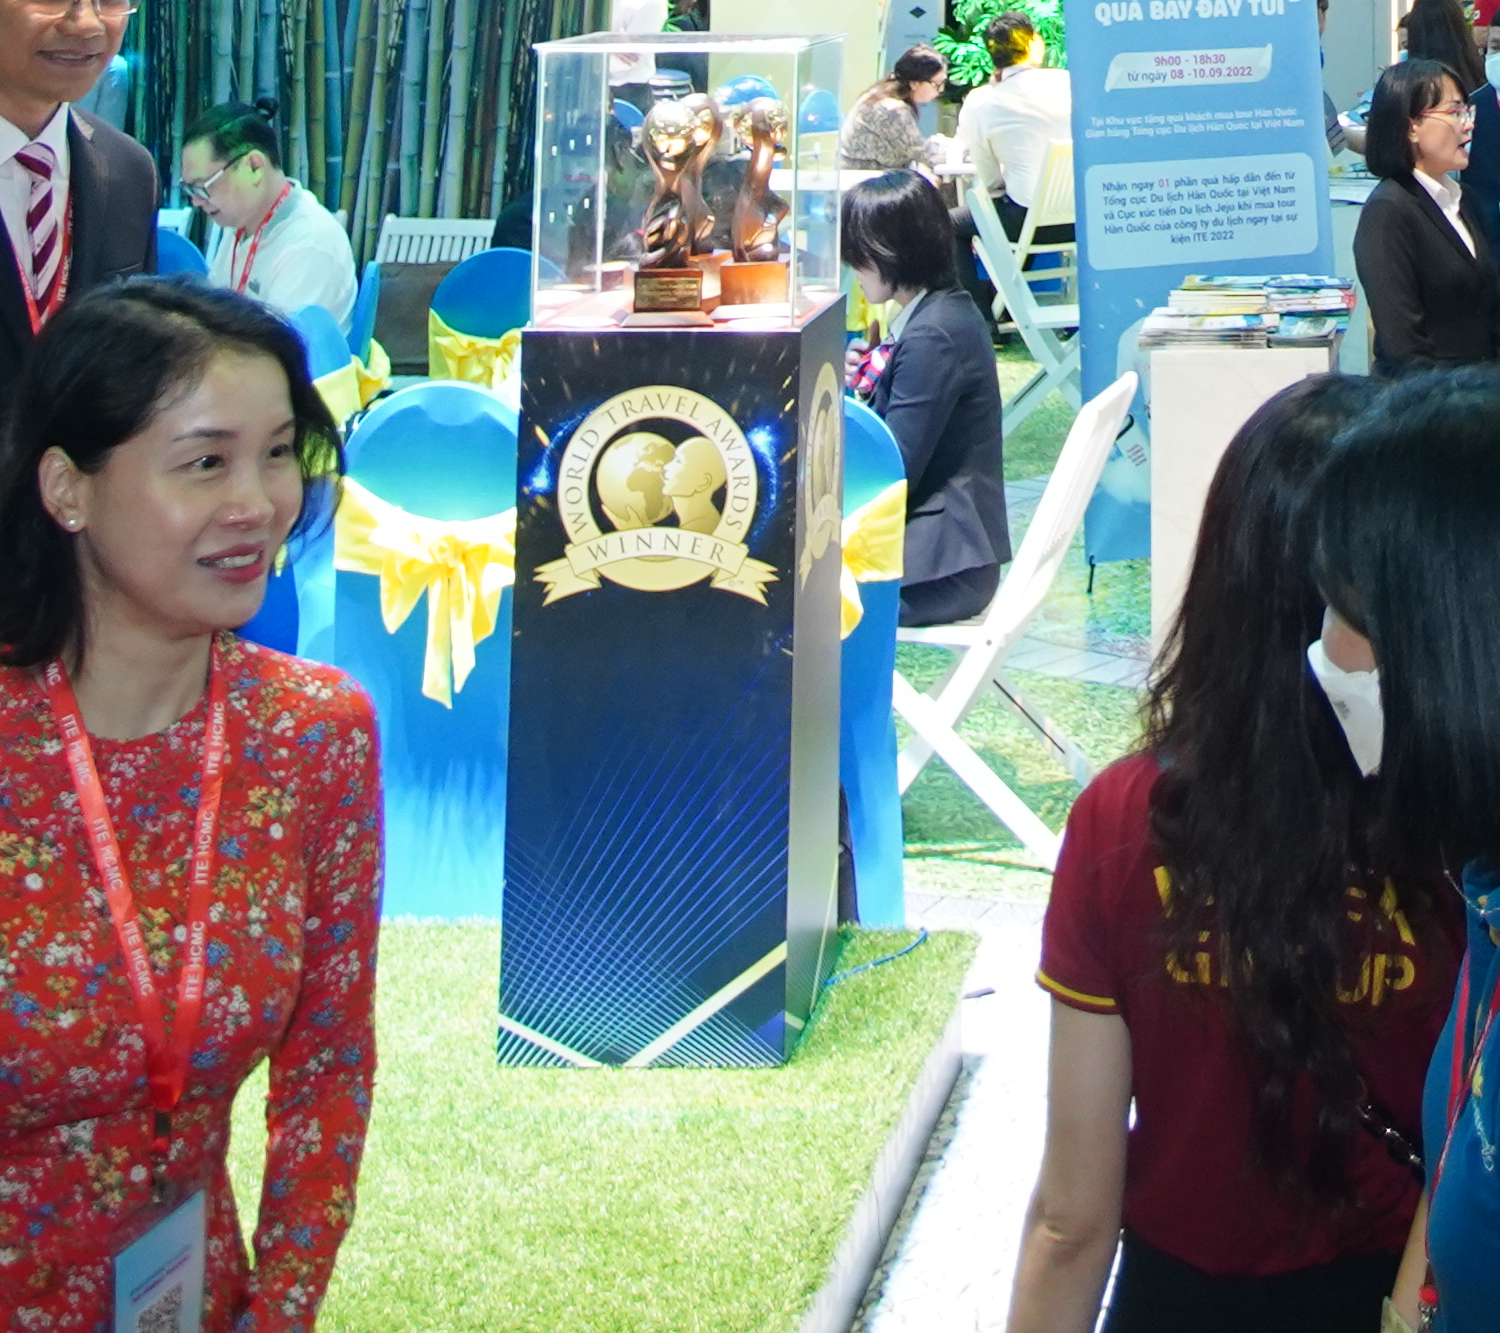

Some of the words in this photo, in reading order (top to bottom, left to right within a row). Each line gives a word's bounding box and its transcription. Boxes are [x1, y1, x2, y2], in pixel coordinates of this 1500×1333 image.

[1154, 56, 1182, 67] 9h00
[1192, 54, 1226, 66] 18h30
[1141, 69, 1167, 85] ngày
[1170, 69, 1185, 80] 08
[1192, 232, 1208, 243] ITE
[1210, 230, 1235, 241] 2022
[565, 428, 600, 535] WORLD
[601, 392, 701, 426] TRAVEL
[705, 418, 750, 531] AWARDS
[586, 532, 725, 564] WINNER
[60, 713, 80, 738] ITE
[209, 701, 226, 743] HCMC
[206, 744, 223, 775] ITE
[92, 817, 112, 843] ITE
[196, 810, 215, 857] HCMC
[194, 856, 211, 885] ITE
[121, 920, 141, 946] ITE
[188, 919, 206, 965] HCMC
[130, 946, 154, 997] HCMC
[184, 965, 201, 1001] ITE
